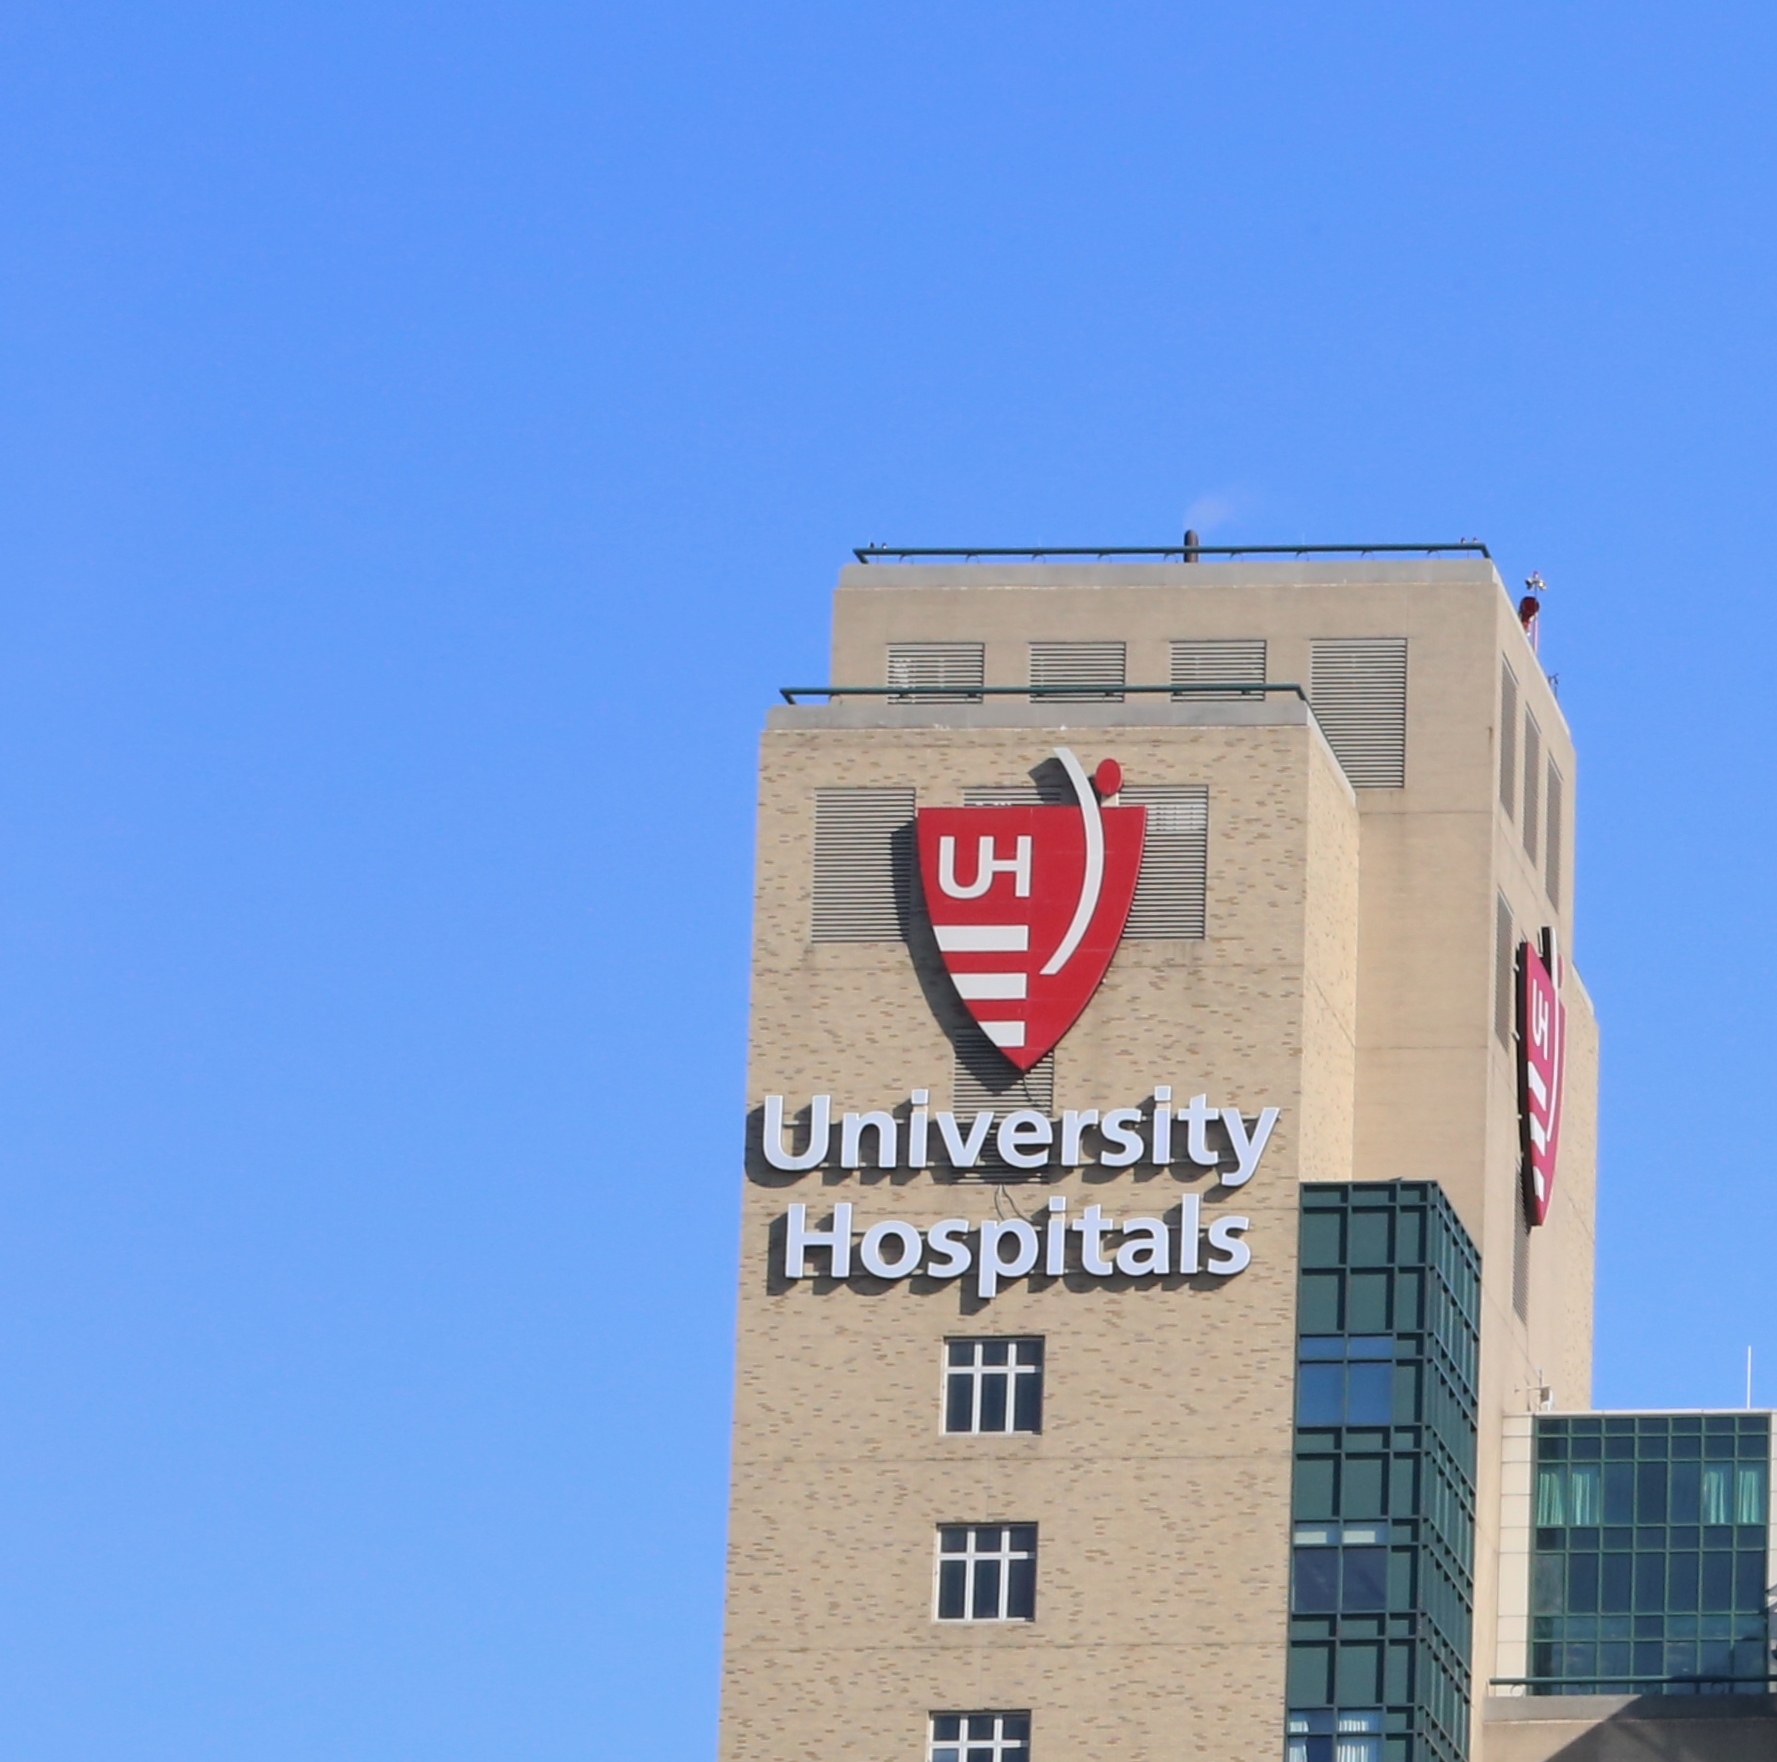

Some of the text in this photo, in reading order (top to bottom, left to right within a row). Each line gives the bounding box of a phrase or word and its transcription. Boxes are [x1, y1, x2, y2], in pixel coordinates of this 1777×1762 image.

[937, 835, 1031, 898] UH
[1532, 978, 1549, 1061] UH
[761, 1085, 1280, 1188] University
[783, 1193, 1252, 1299] Hospitals
